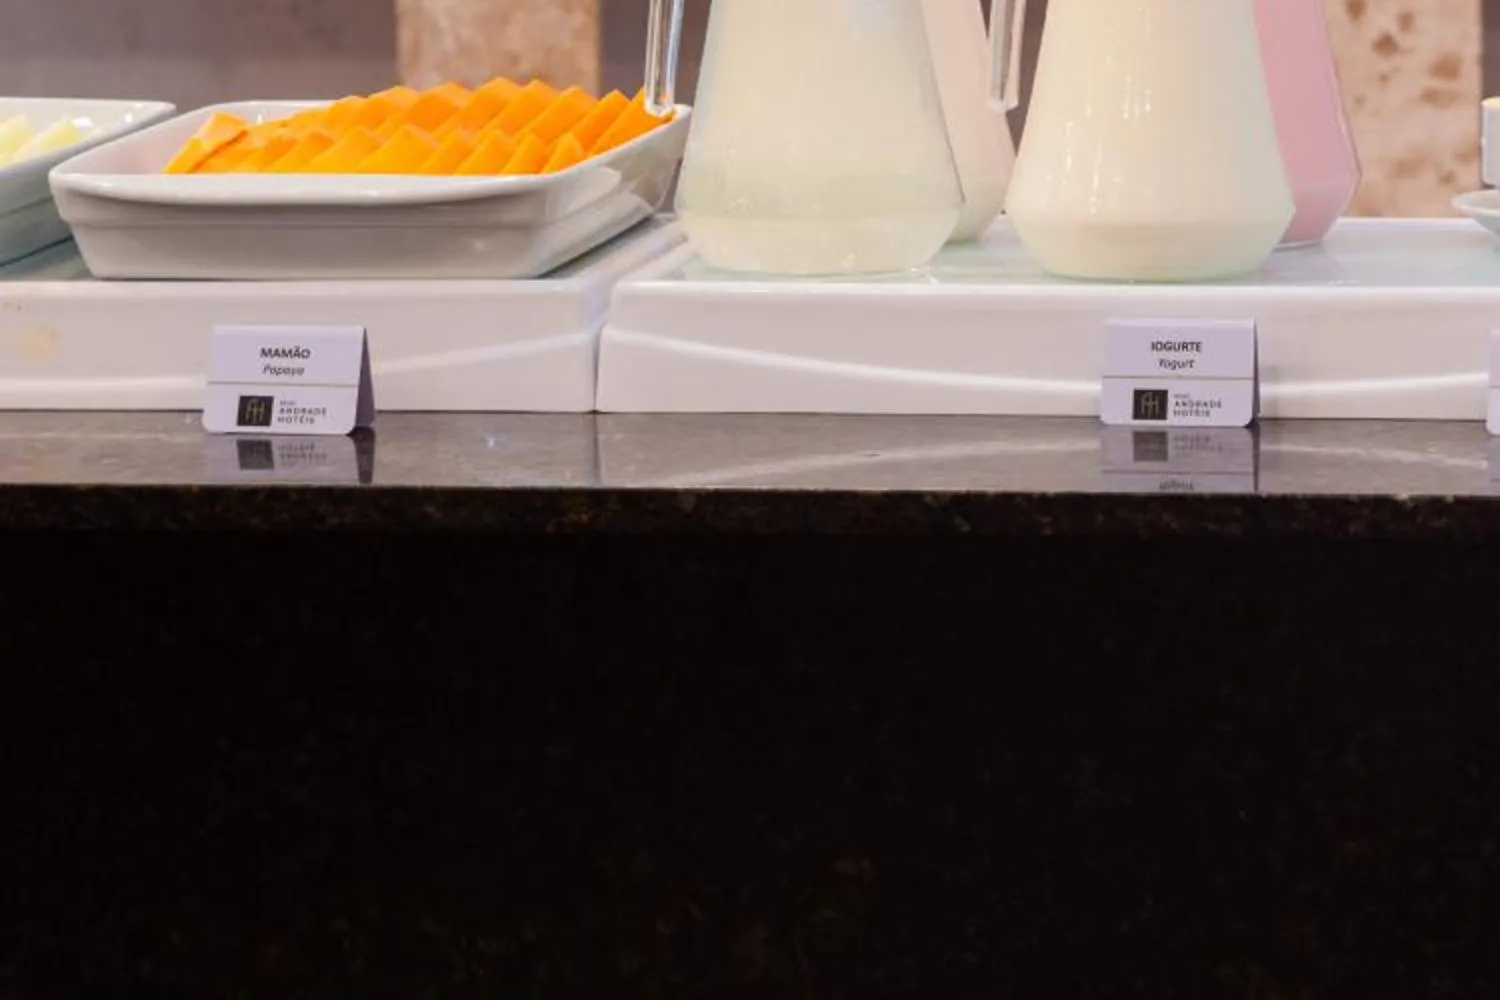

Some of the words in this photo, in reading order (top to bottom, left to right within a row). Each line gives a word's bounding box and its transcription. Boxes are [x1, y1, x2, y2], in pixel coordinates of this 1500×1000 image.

[260, 346, 311, 359] MAMÃO
[1151, 341, 1203, 352] IOGURTE
[263, 363, 305, 376] Papaya
[1159, 358, 1196, 371] Yogurt
